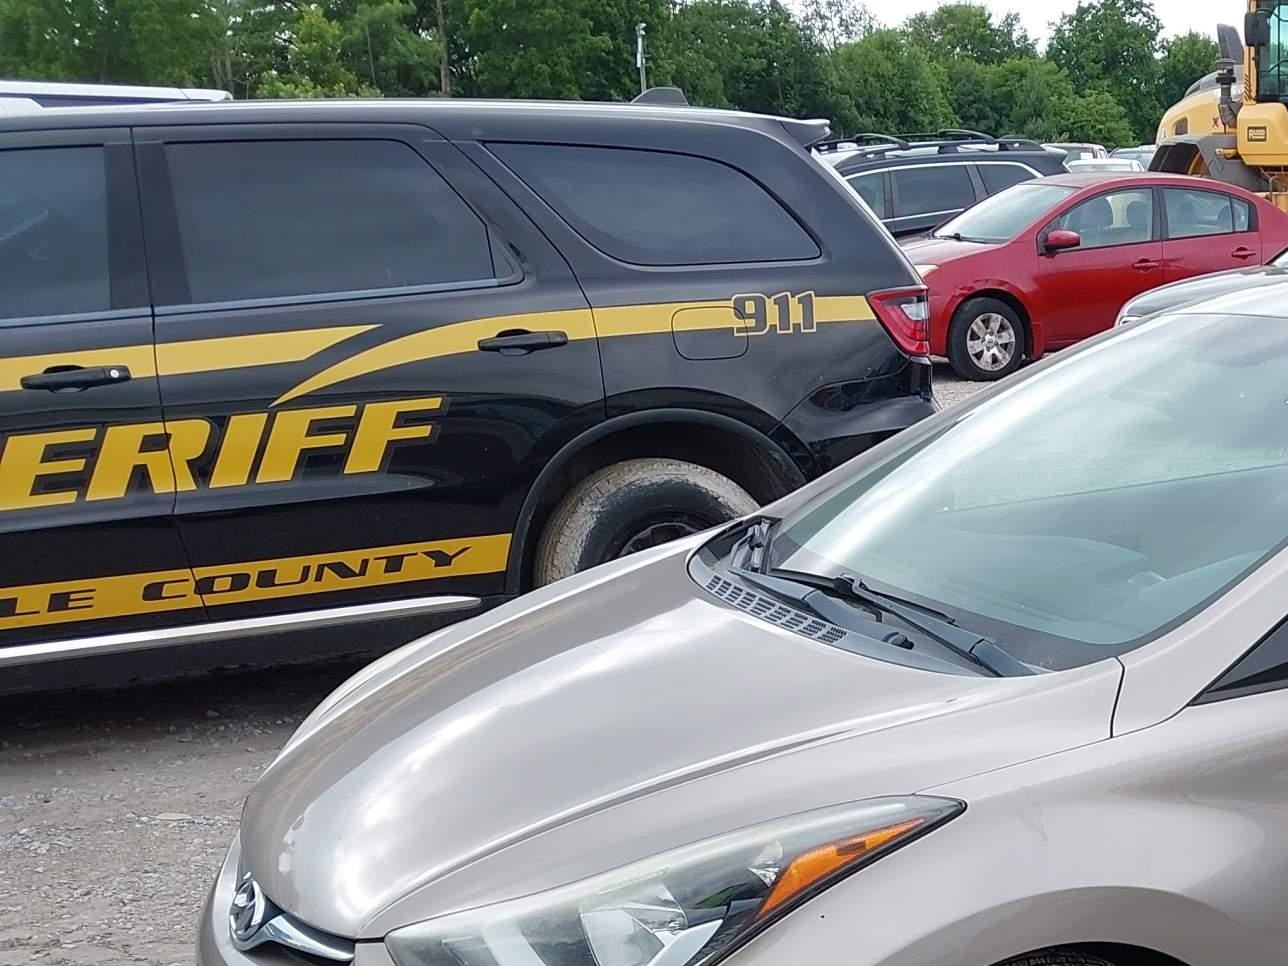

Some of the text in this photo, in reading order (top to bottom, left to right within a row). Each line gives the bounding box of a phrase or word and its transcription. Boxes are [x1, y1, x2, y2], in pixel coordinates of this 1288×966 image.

[731, 291, 817, 337] 911
[0, 396, 443, 511] ERIFF
[142, 546, 473, 602] COUNTY
